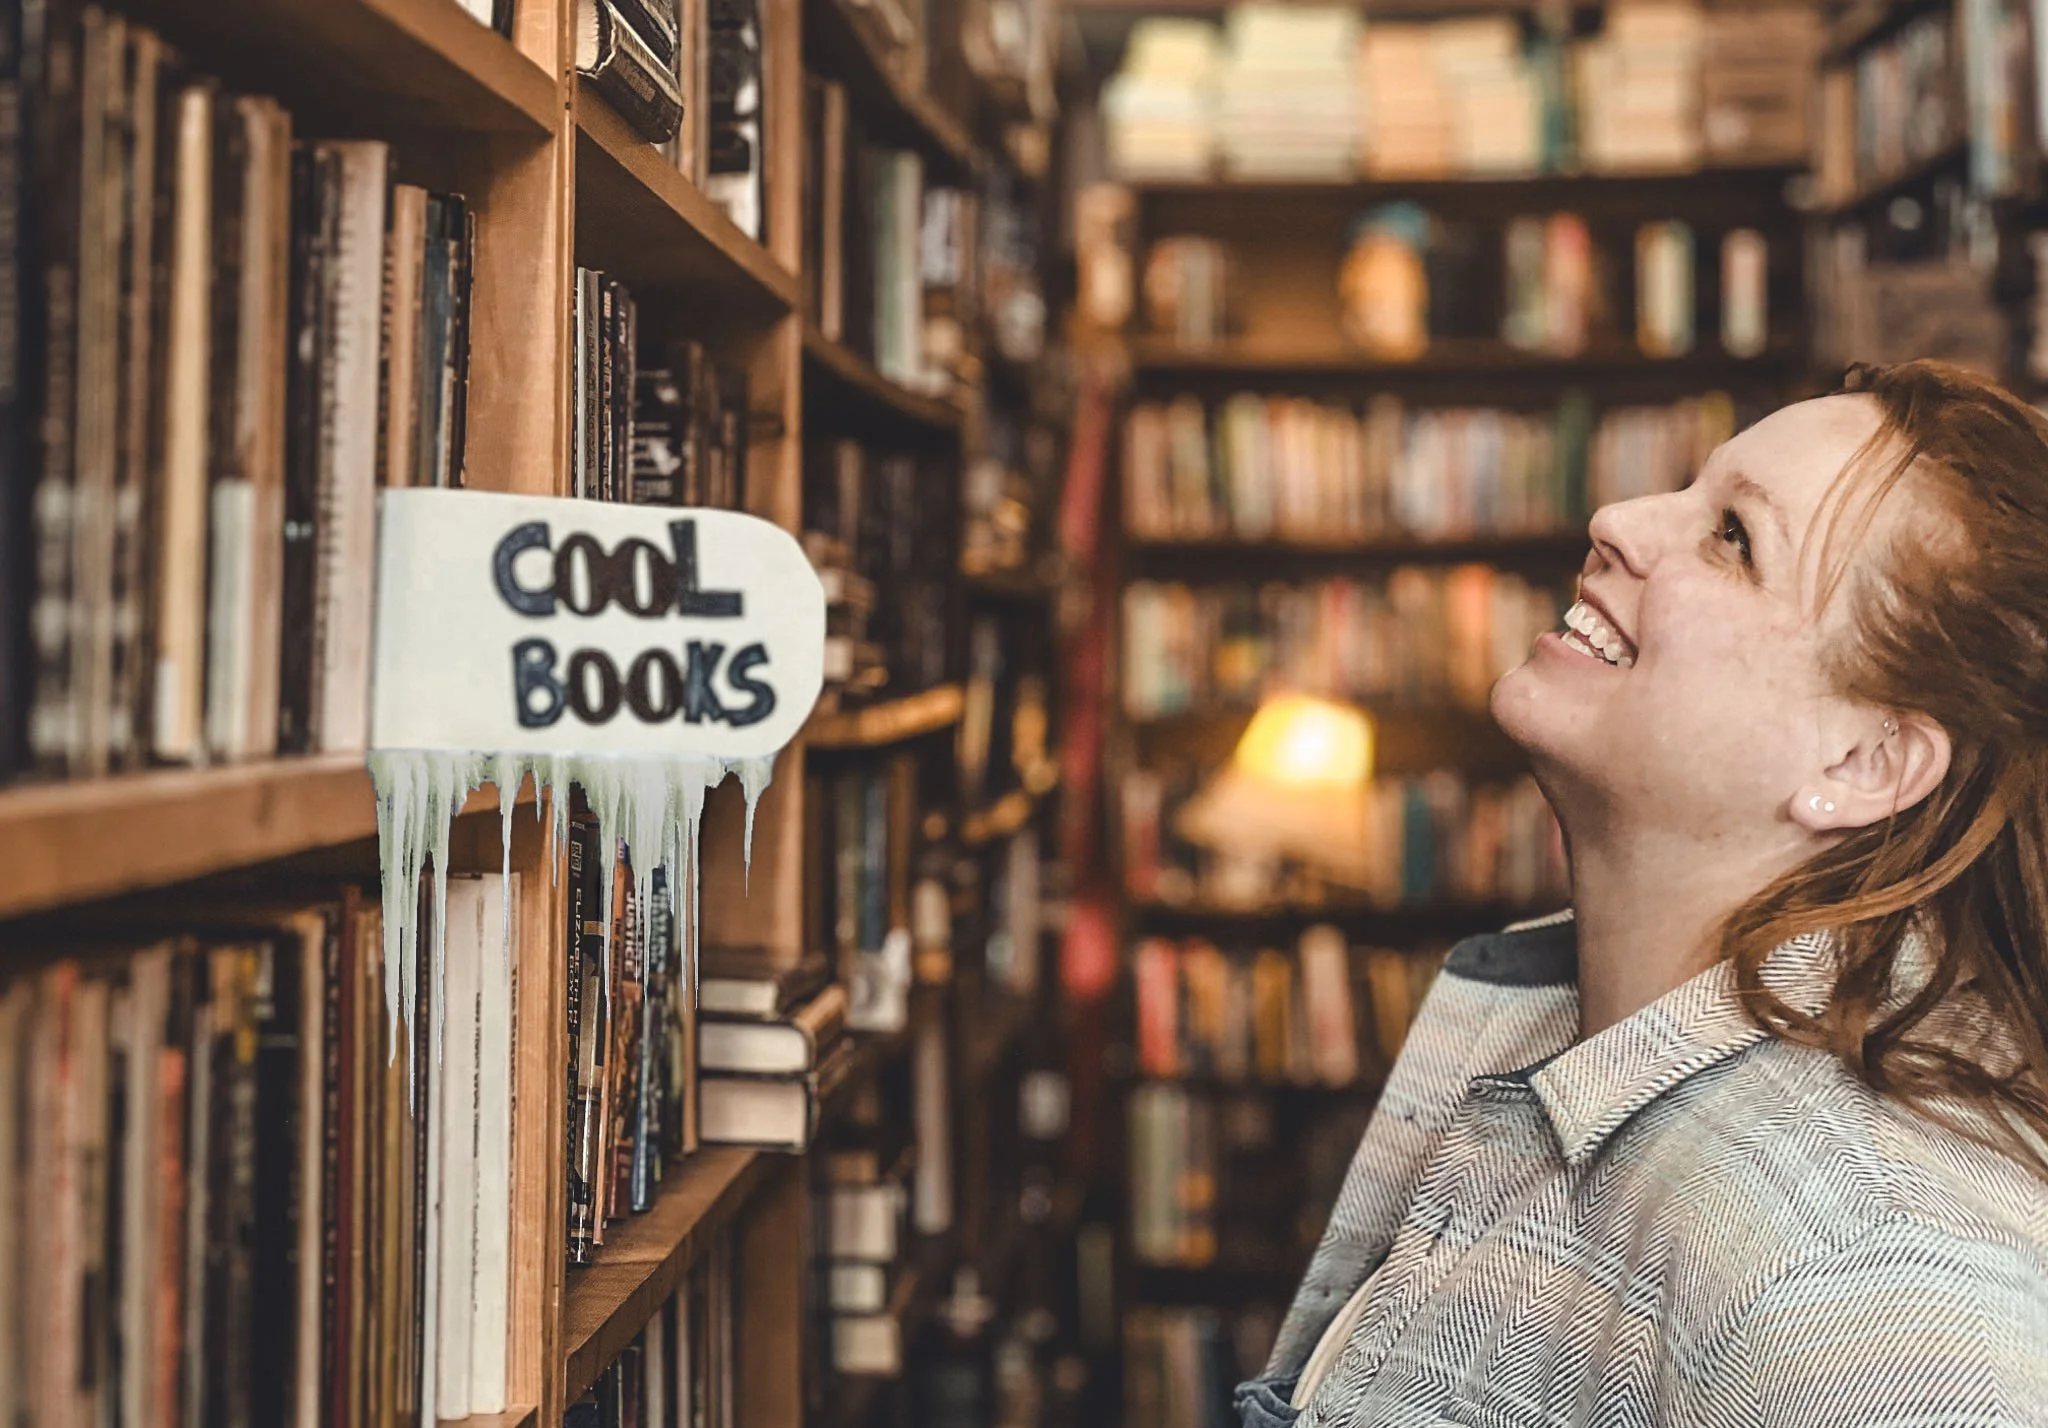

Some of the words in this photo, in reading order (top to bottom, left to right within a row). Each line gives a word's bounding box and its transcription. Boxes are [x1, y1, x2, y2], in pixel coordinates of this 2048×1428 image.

[492, 518, 744, 617] COOL
[512, 637, 777, 729] BOOKS
[573, 887, 582, 1002] ELIZABETH
[624, 891, 636, 973] JUSTICE
